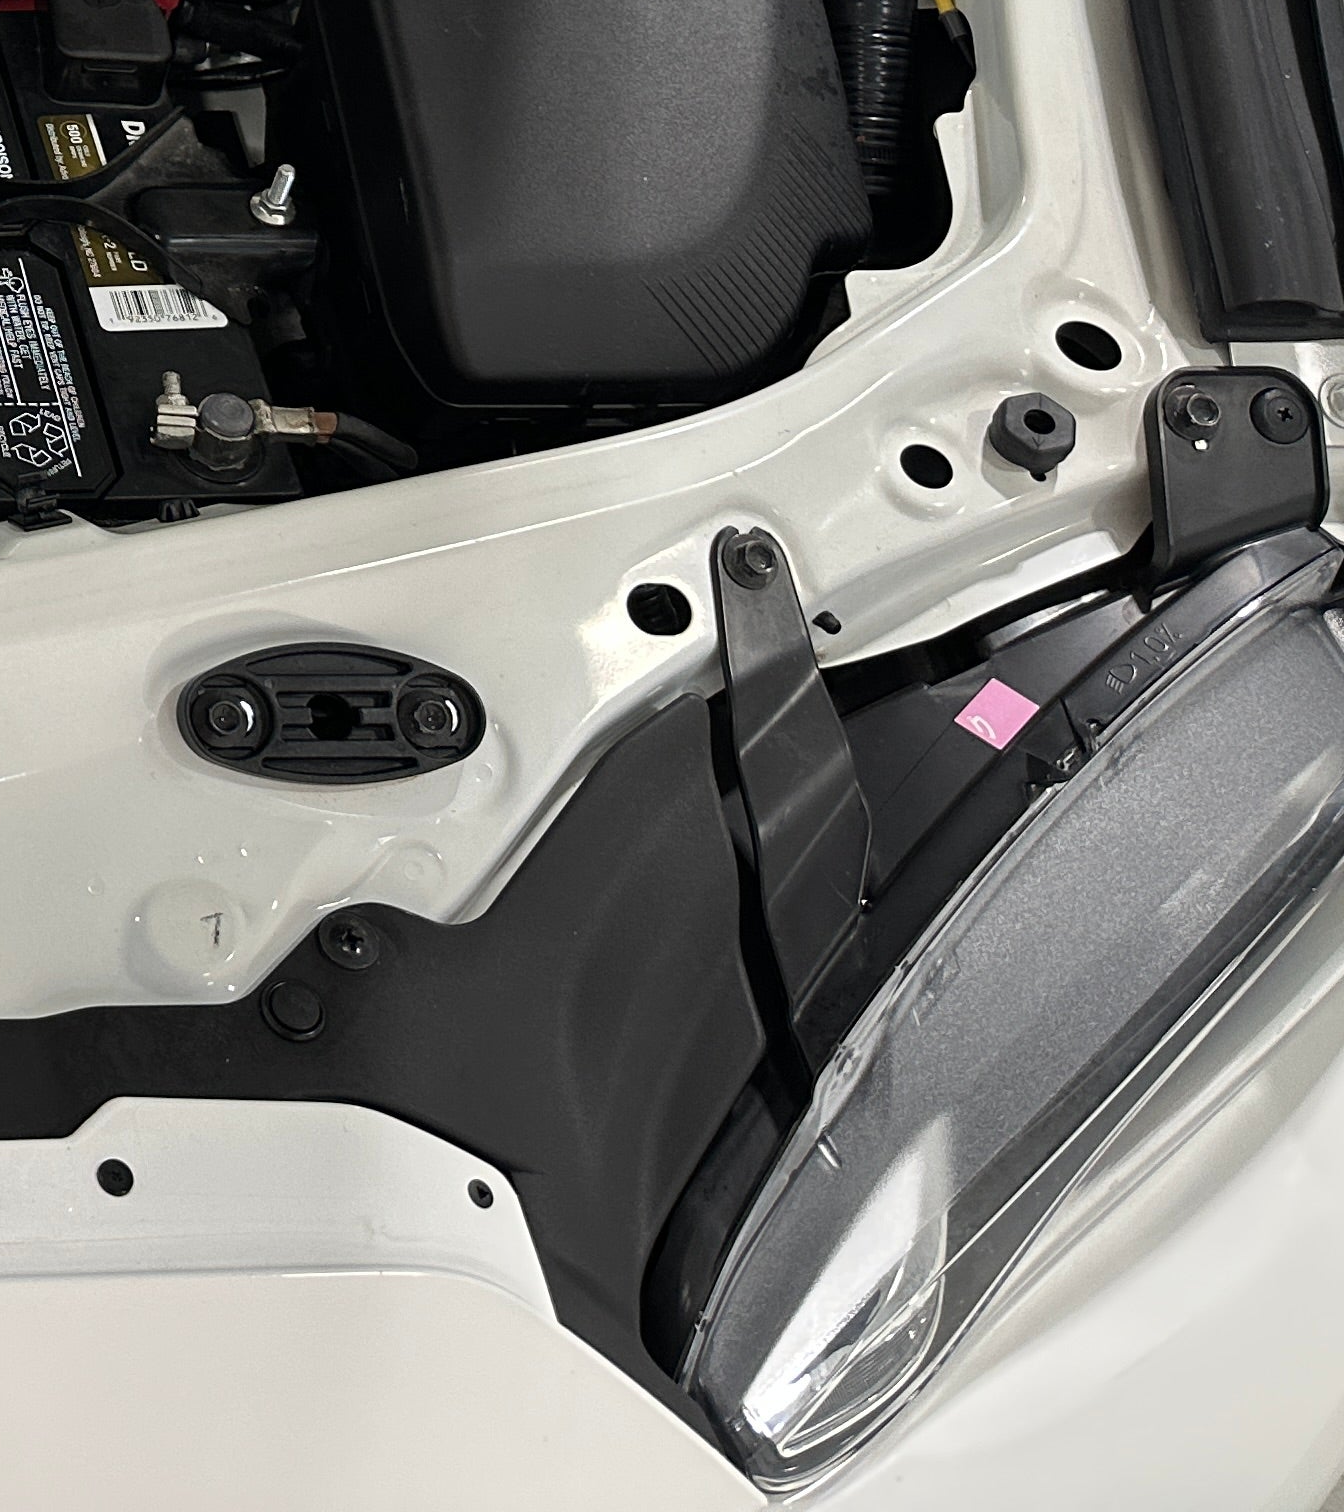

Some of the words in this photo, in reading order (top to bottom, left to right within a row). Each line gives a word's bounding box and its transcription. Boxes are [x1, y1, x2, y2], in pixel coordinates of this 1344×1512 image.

[66, 124, 83, 144] 500
[16, 293, 31, 319] FLUSH
[5, 294, 18, 314] WITH
[18, 344, 33, 360] GET
[166, 313, 199, 322] 76812
[3, 327, 18, 348] HELP
[22, 319, 37, 340] EYES
[9, 349, 24, 369] FAST
[28, 340, 52, 391] IMMEDIATELY
